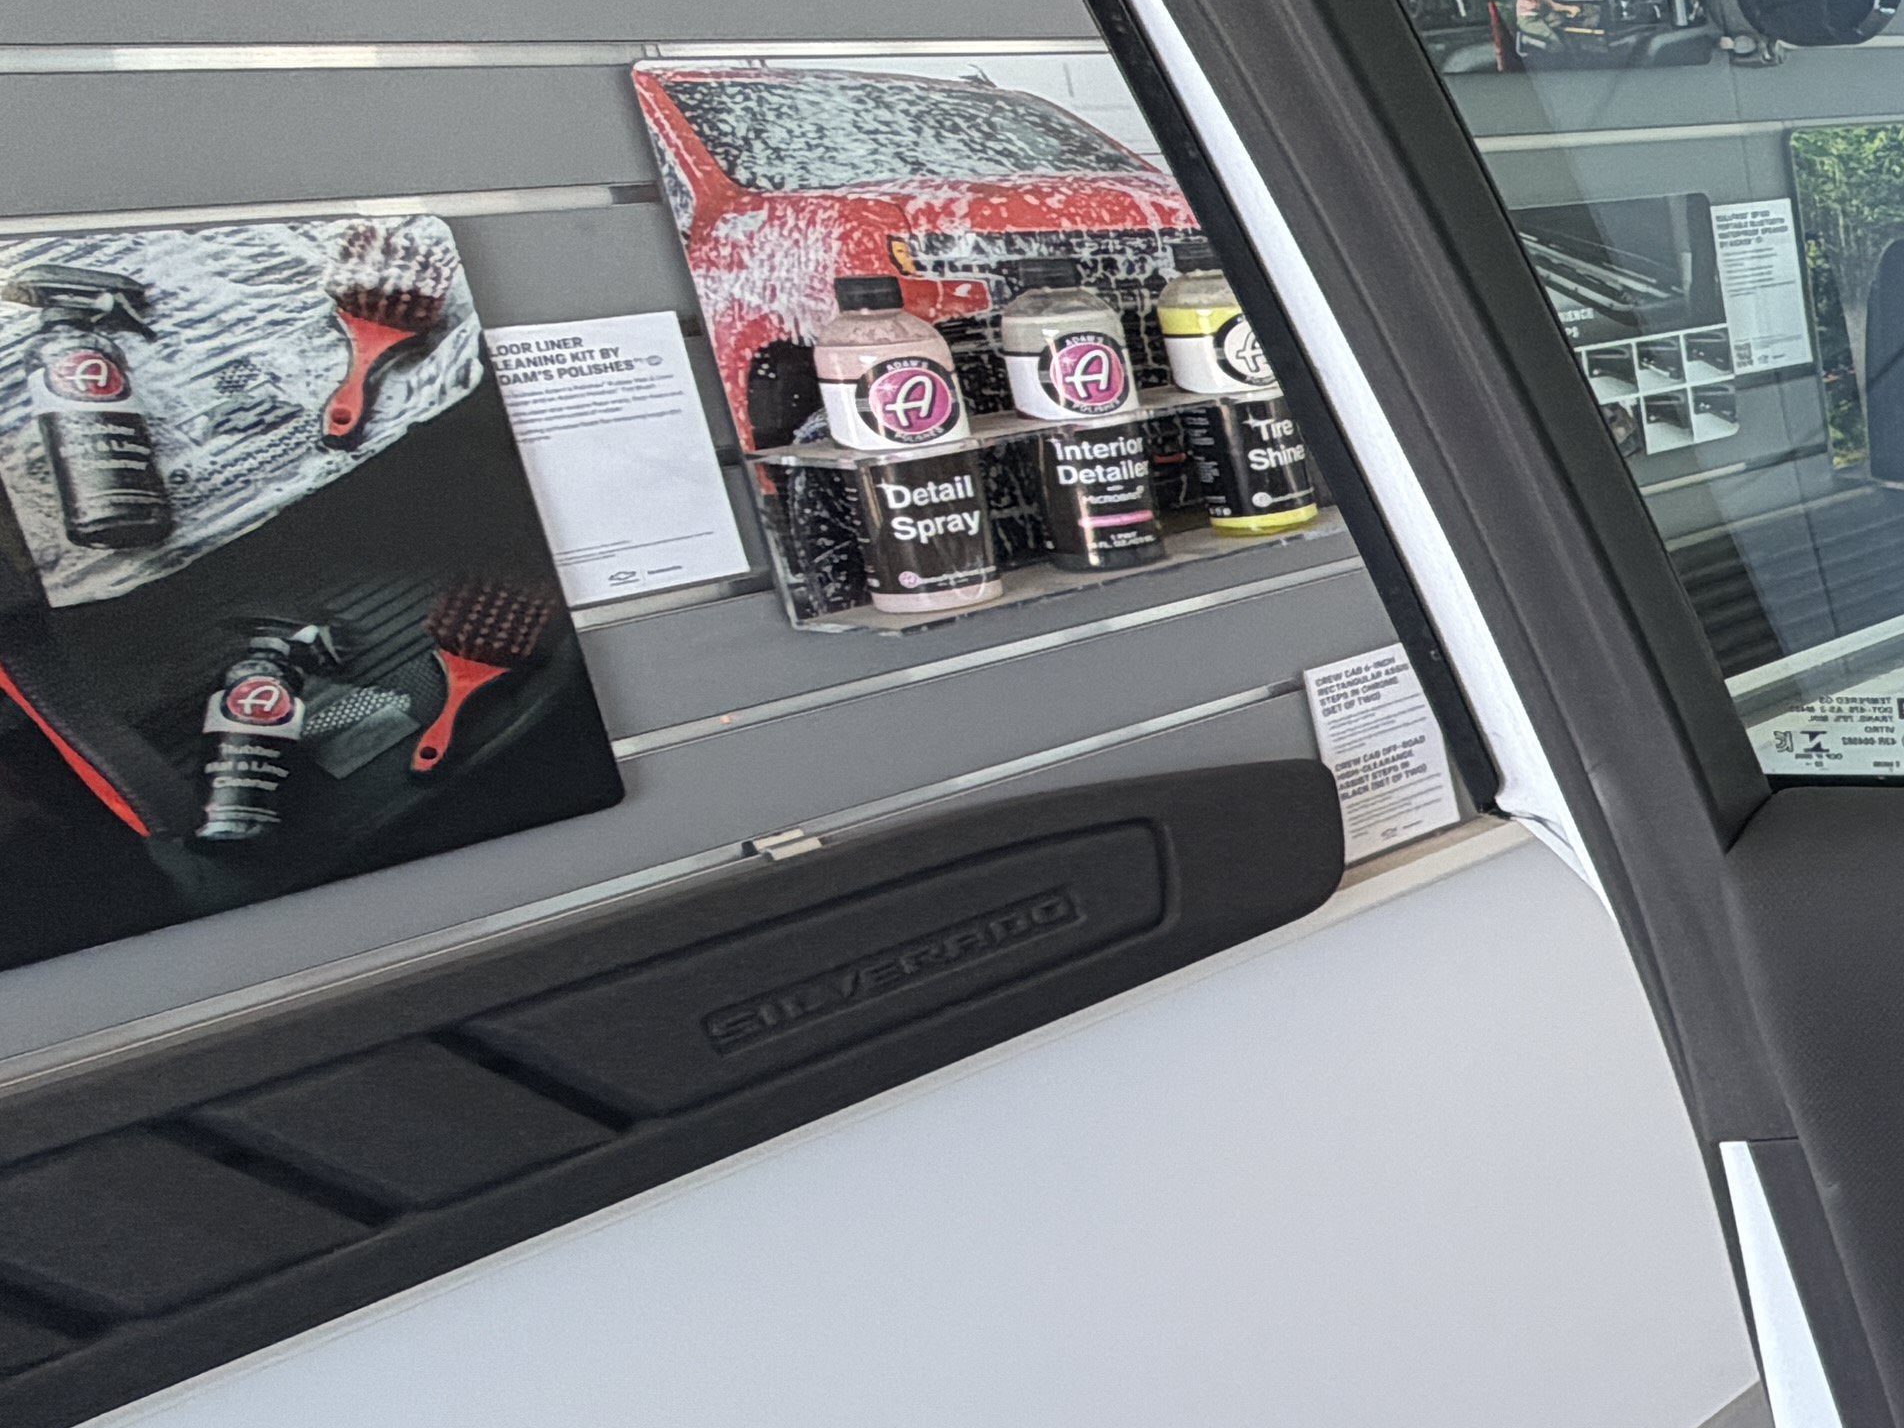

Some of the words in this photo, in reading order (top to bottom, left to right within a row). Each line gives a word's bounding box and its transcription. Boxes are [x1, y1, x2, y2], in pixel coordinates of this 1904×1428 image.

[490, 342, 532, 357] LOOR
[536, 337, 583, 353] LINER
[492, 353, 567, 372] LEANING
[571, 349, 595, 363] KIT
[599, 347, 620, 359] BY
[499, 368, 554, 386] DAM'S
[1256, 418, 1294, 441] Tire
[1055, 436, 1144, 461] Interior
[1248, 444, 1305, 471] Shine
[1057, 459, 1149, 485] Detailer
[884, 475, 975, 509] Detail
[891, 509, 981, 544] Spray
[709, 895, 1070, 1045] SILVERADO
